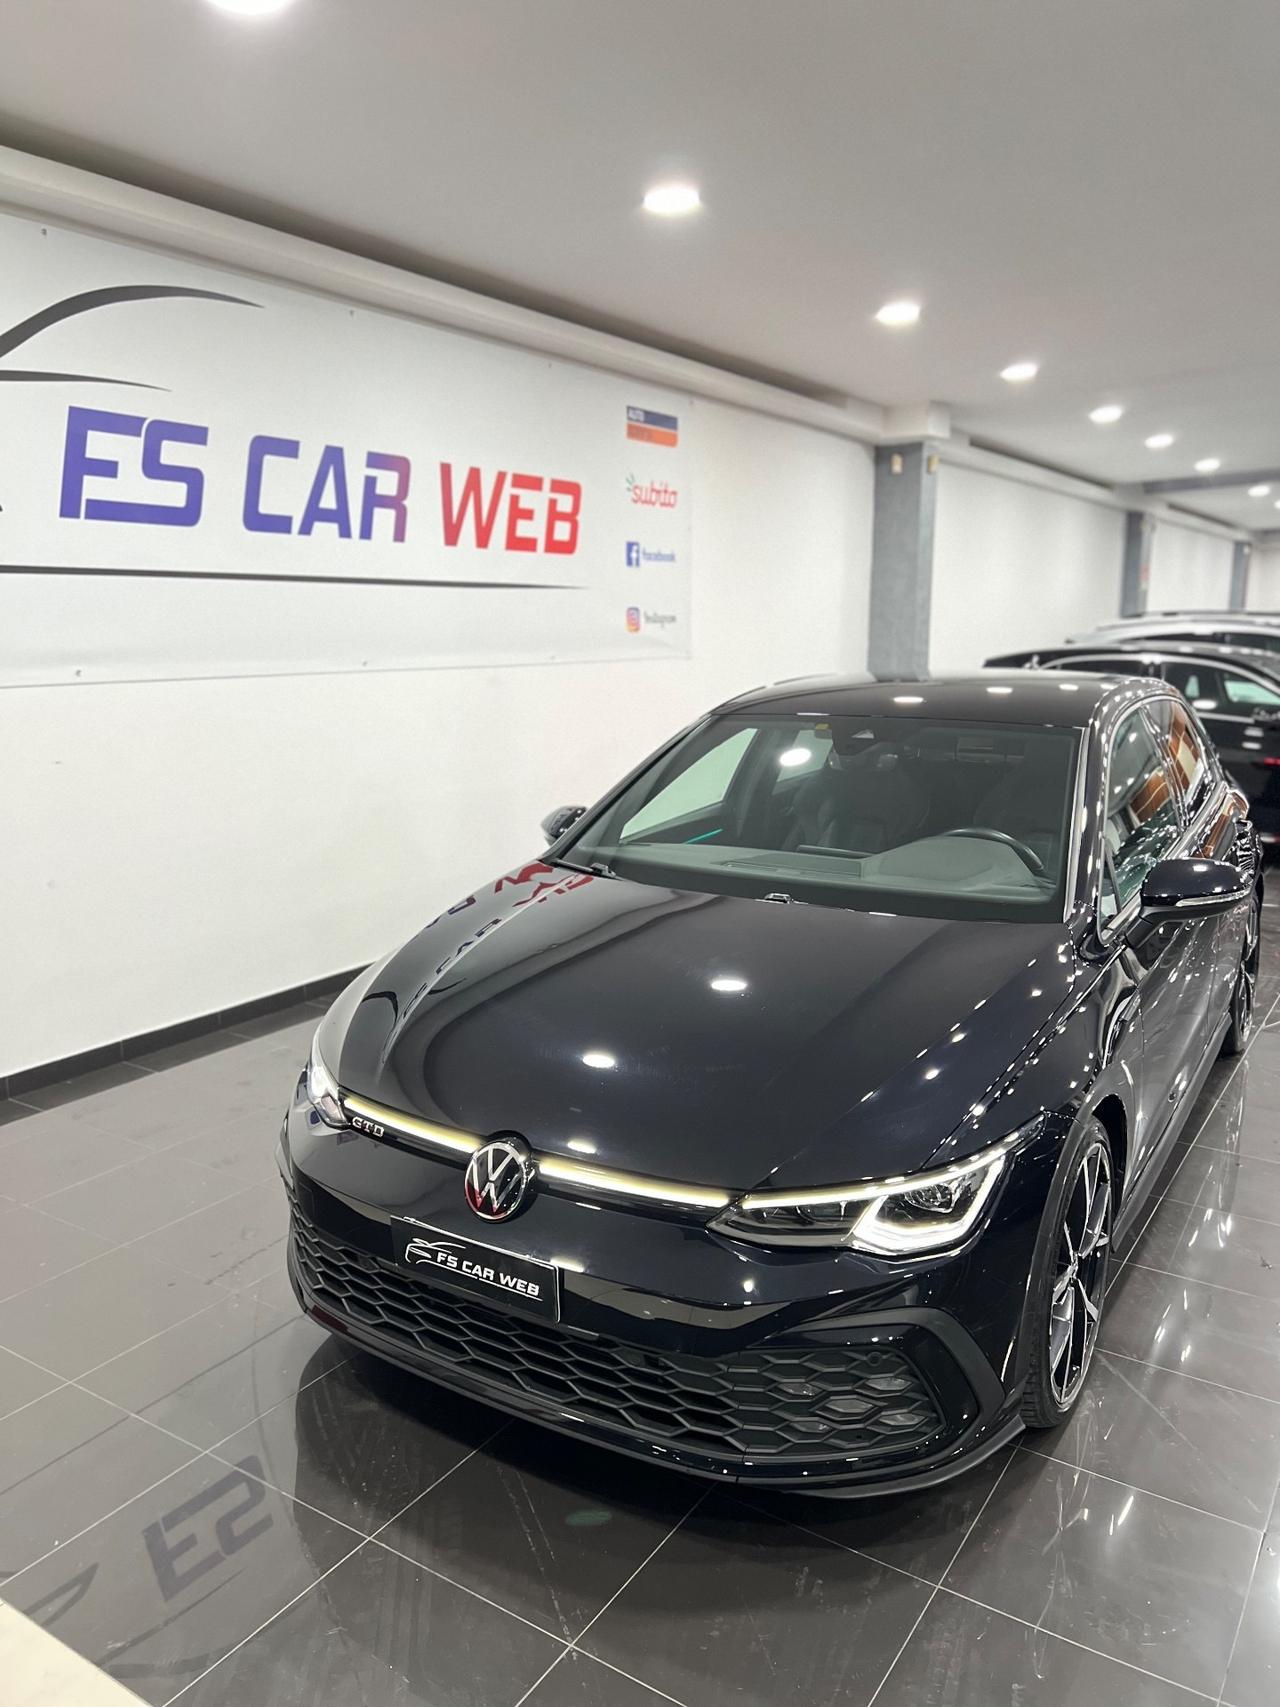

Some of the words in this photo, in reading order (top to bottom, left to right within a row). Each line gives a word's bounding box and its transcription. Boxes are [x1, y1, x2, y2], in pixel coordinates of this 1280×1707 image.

[59, 405, 209, 527] FS
[242, 435, 411, 543] CAR
[439, 462, 583, 555] WEB
[632, 480, 678, 508] subito
[352, 1116, 385, 1137] GTD
[437, 1252, 458, 1268] FS
[462, 1260, 495, 1281] CAR
[499, 1272, 540, 1296] WEB
